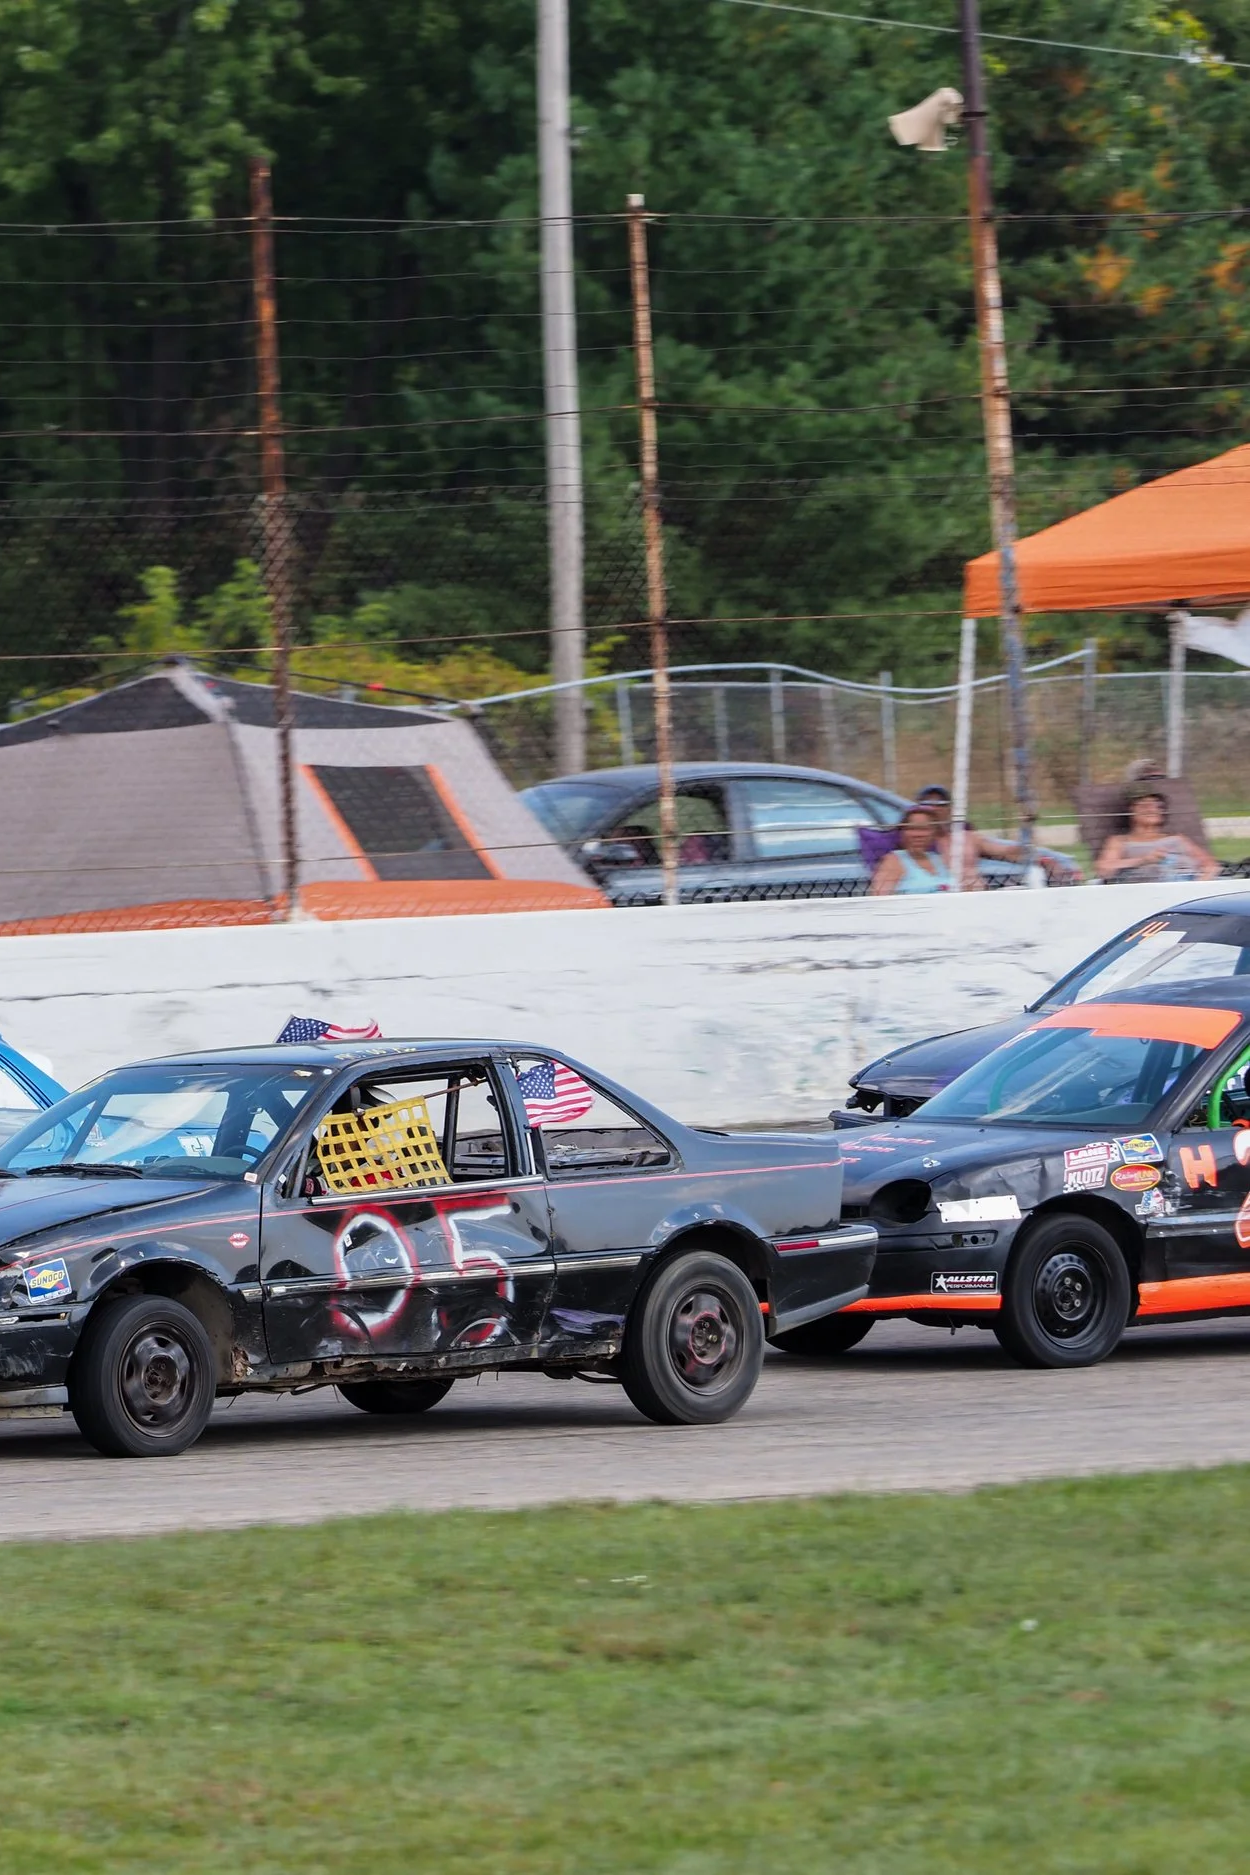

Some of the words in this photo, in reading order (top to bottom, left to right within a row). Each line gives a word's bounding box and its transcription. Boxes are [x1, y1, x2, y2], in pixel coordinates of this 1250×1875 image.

[1124, 1141, 1154, 1151] SUNOCO
[1179, 1144, 1218, 1189] H
[1068, 1167, 1105, 1185] KLOTZ
[332, 1193, 516, 1346] 05
[31, 1271, 64, 1288] SUNOCO
[946, 1275, 995, 1283] ALLSTAR
